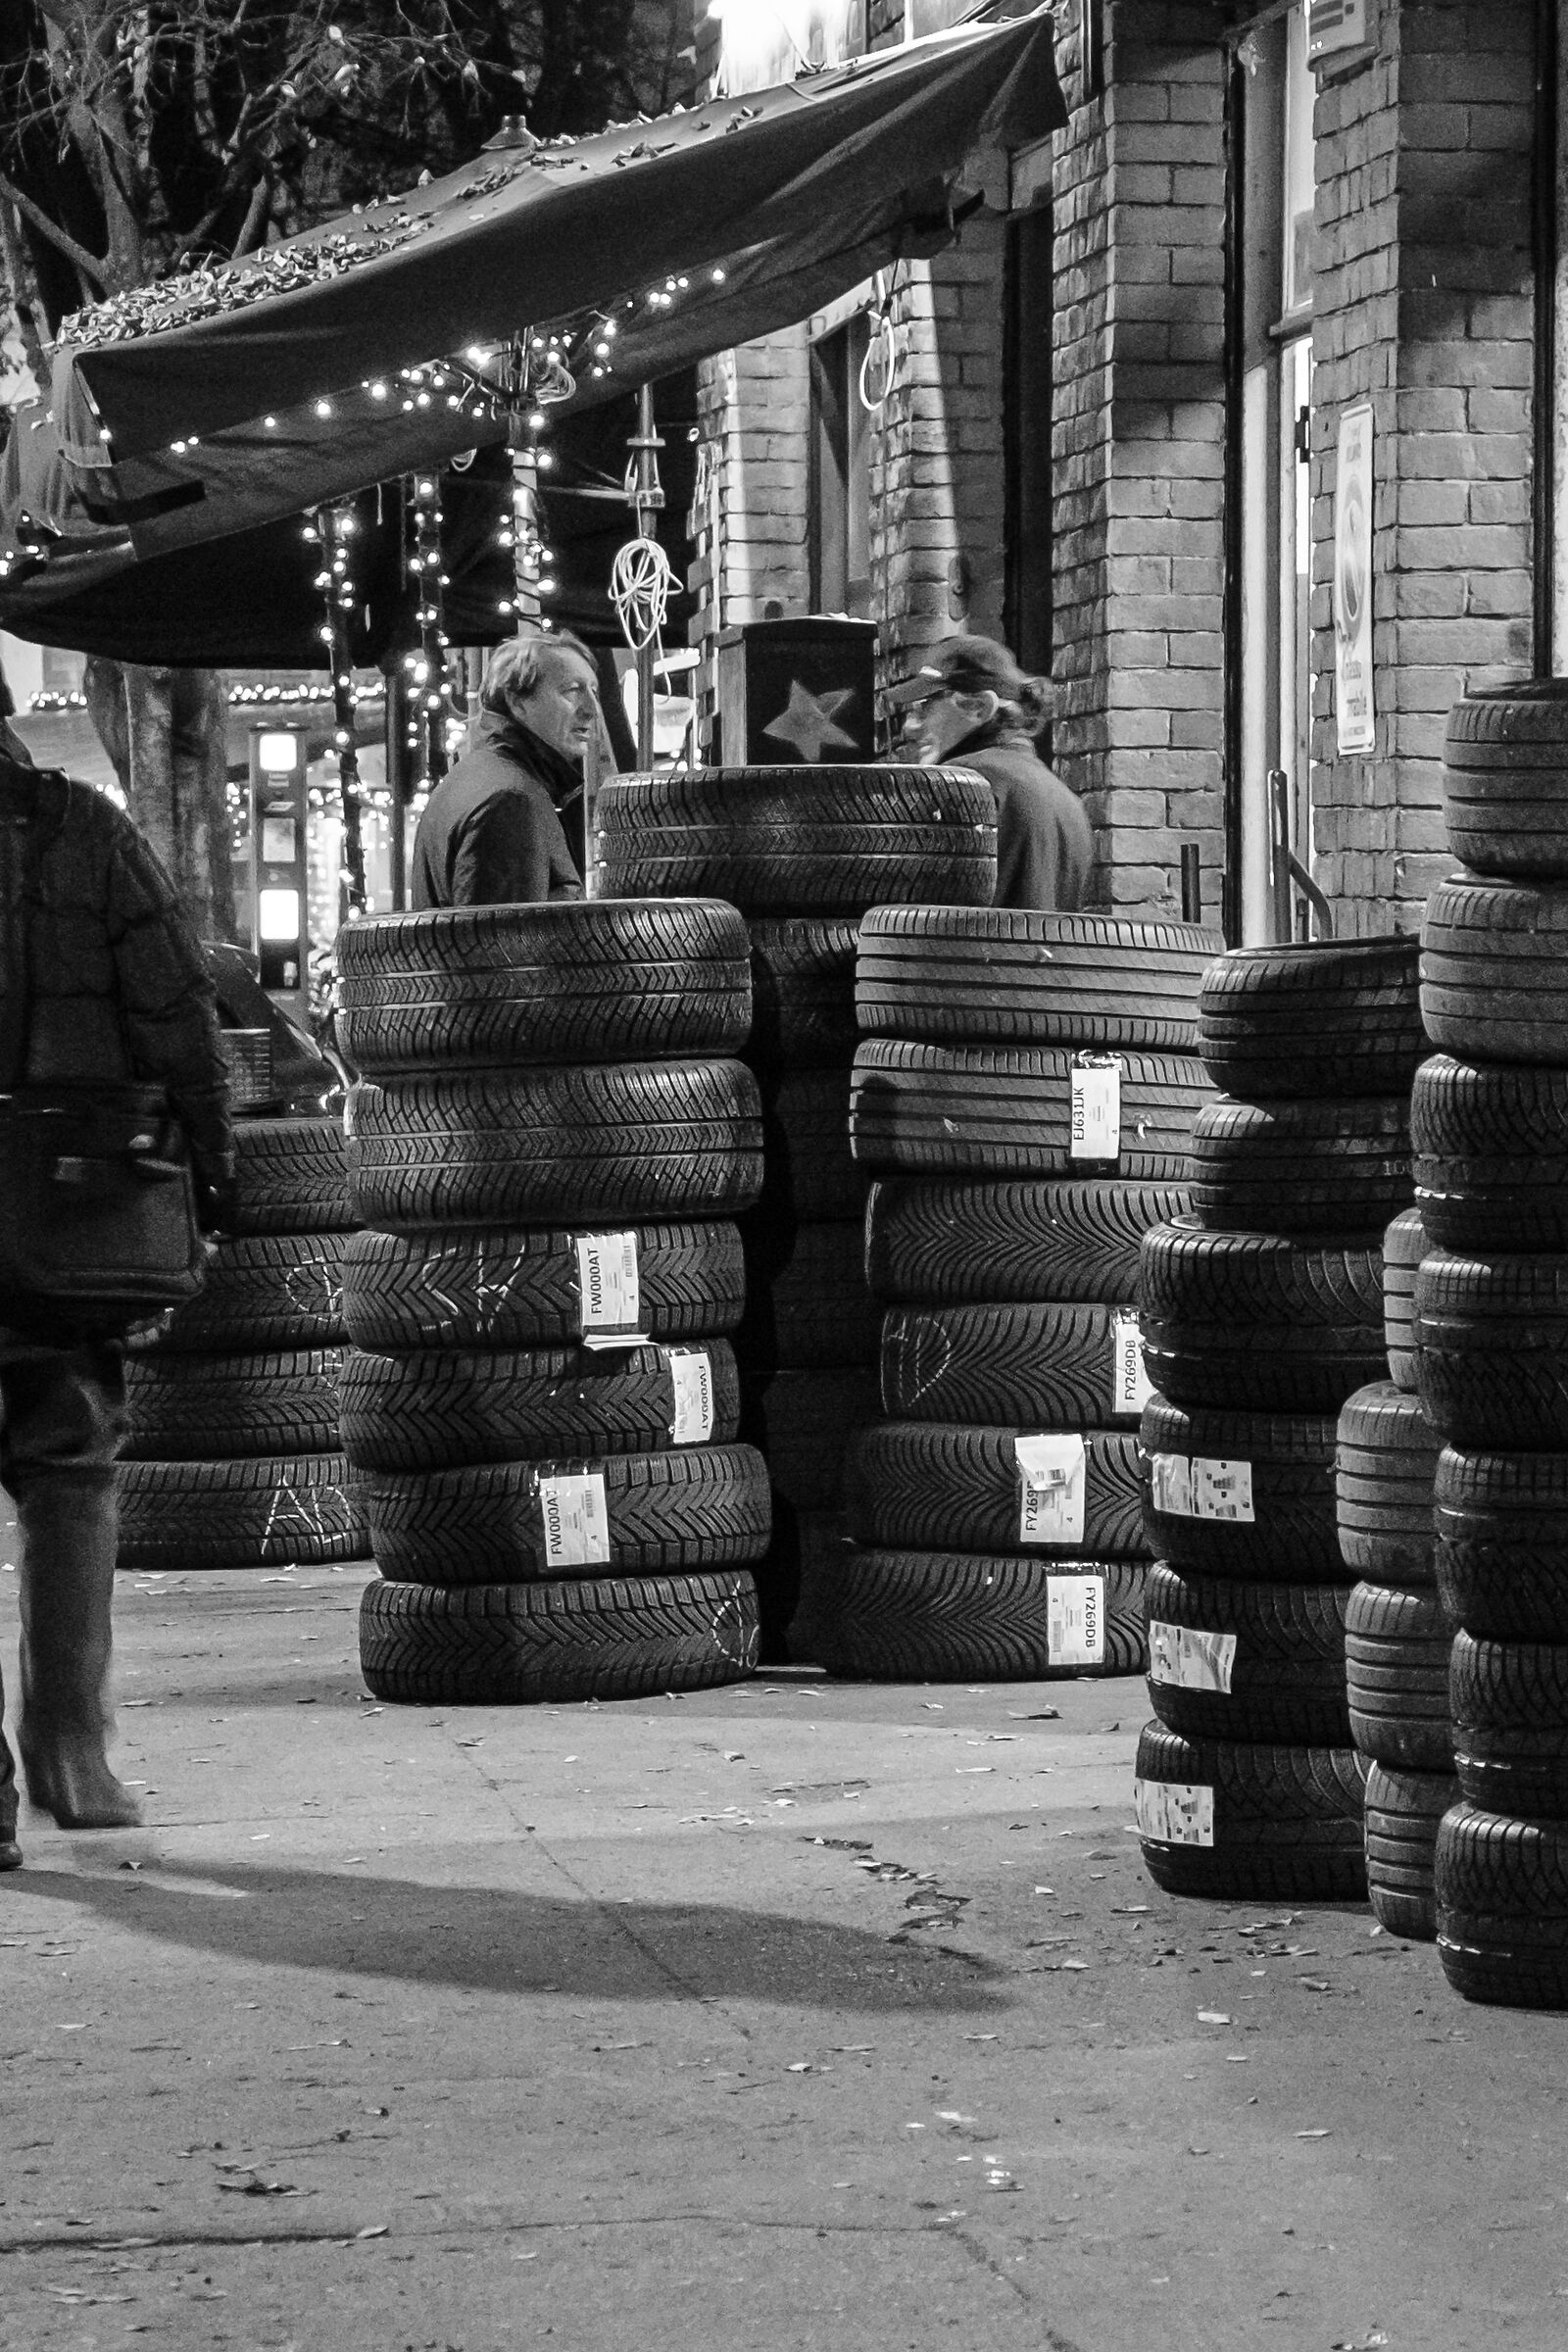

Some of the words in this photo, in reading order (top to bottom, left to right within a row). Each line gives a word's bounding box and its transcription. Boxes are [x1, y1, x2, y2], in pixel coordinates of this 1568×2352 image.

[1073, 1087, 1085, 1141] EJ631JK
[587, 1247, 603, 1315] FW000AT
[698, 1365, 710, 1431] FW000AT
[1124, 1339, 1137, 1401] FY269DB
[546, 1489, 564, 1555] FW000AT
[1085, 1587, 1097, 1648] FY269DB
